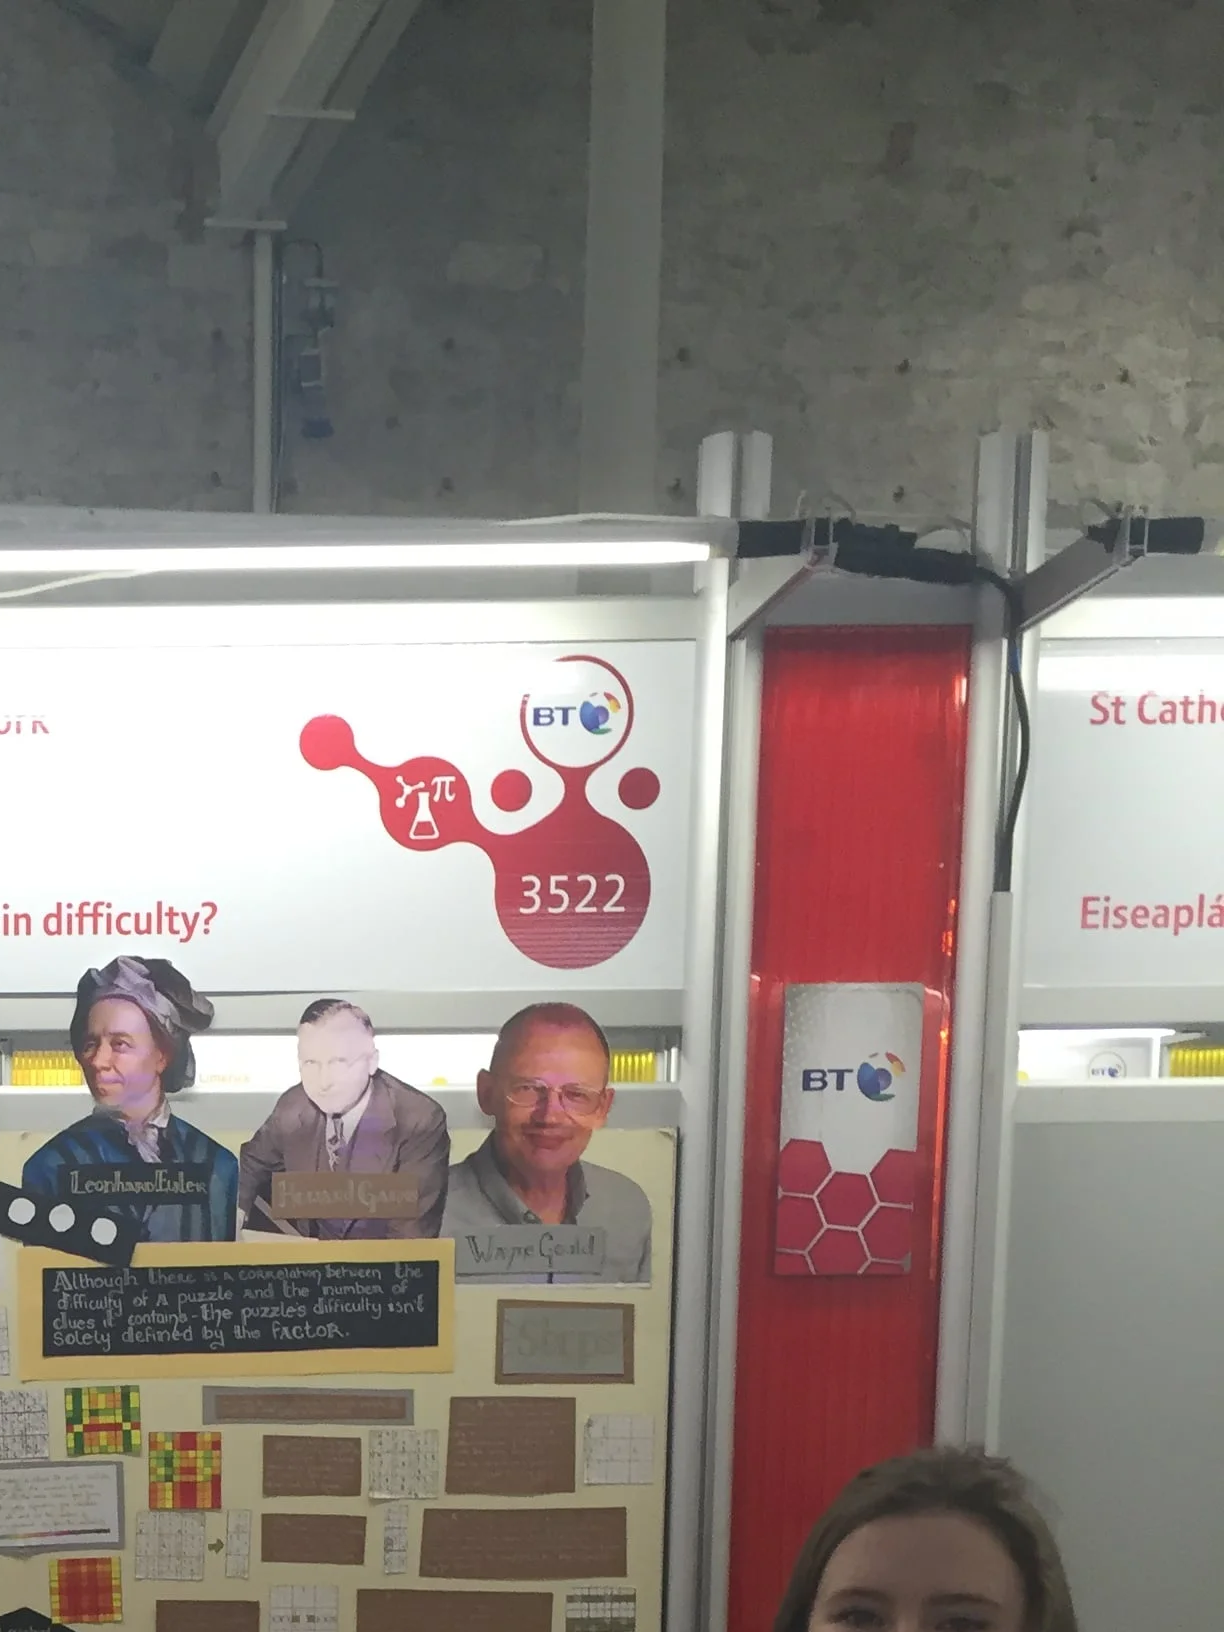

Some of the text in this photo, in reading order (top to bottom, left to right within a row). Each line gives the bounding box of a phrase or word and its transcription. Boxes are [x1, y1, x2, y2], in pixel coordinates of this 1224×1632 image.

[533, 707, 576, 727] BT
[1089, 690, 1224, 725] St Cath
[519, 875, 626, 914] 3522
[3, 905, 32, 936] in
[43, 902, 218, 943] difficulty?
[1080, 893, 1224, 936] Eiseaplá
[802, 1069, 852, 1091] BT
[52, 1268, 139, 1294] Although
[148, 1268, 196, 1285] there
[394, 1262, 424, 1279] the
[132, 1289, 149, 1307] of
[177, 1285, 234, 1313] puzzle
[282, 1280, 310, 1298] the
[391, 1279, 409, 1295] of
[52, 1311, 96, 1331] clues
[103, 1309, 114, 1328] it
[200, 1304, 234, 1327] the
[241, 1301, 308, 1325] puzzle's
[312, 1298, 383, 1320] difficulty
[53, 1330, 111, 1352] solely
[121, 1326, 193, 1343] defined
[202, 1325, 226, 1350] by
